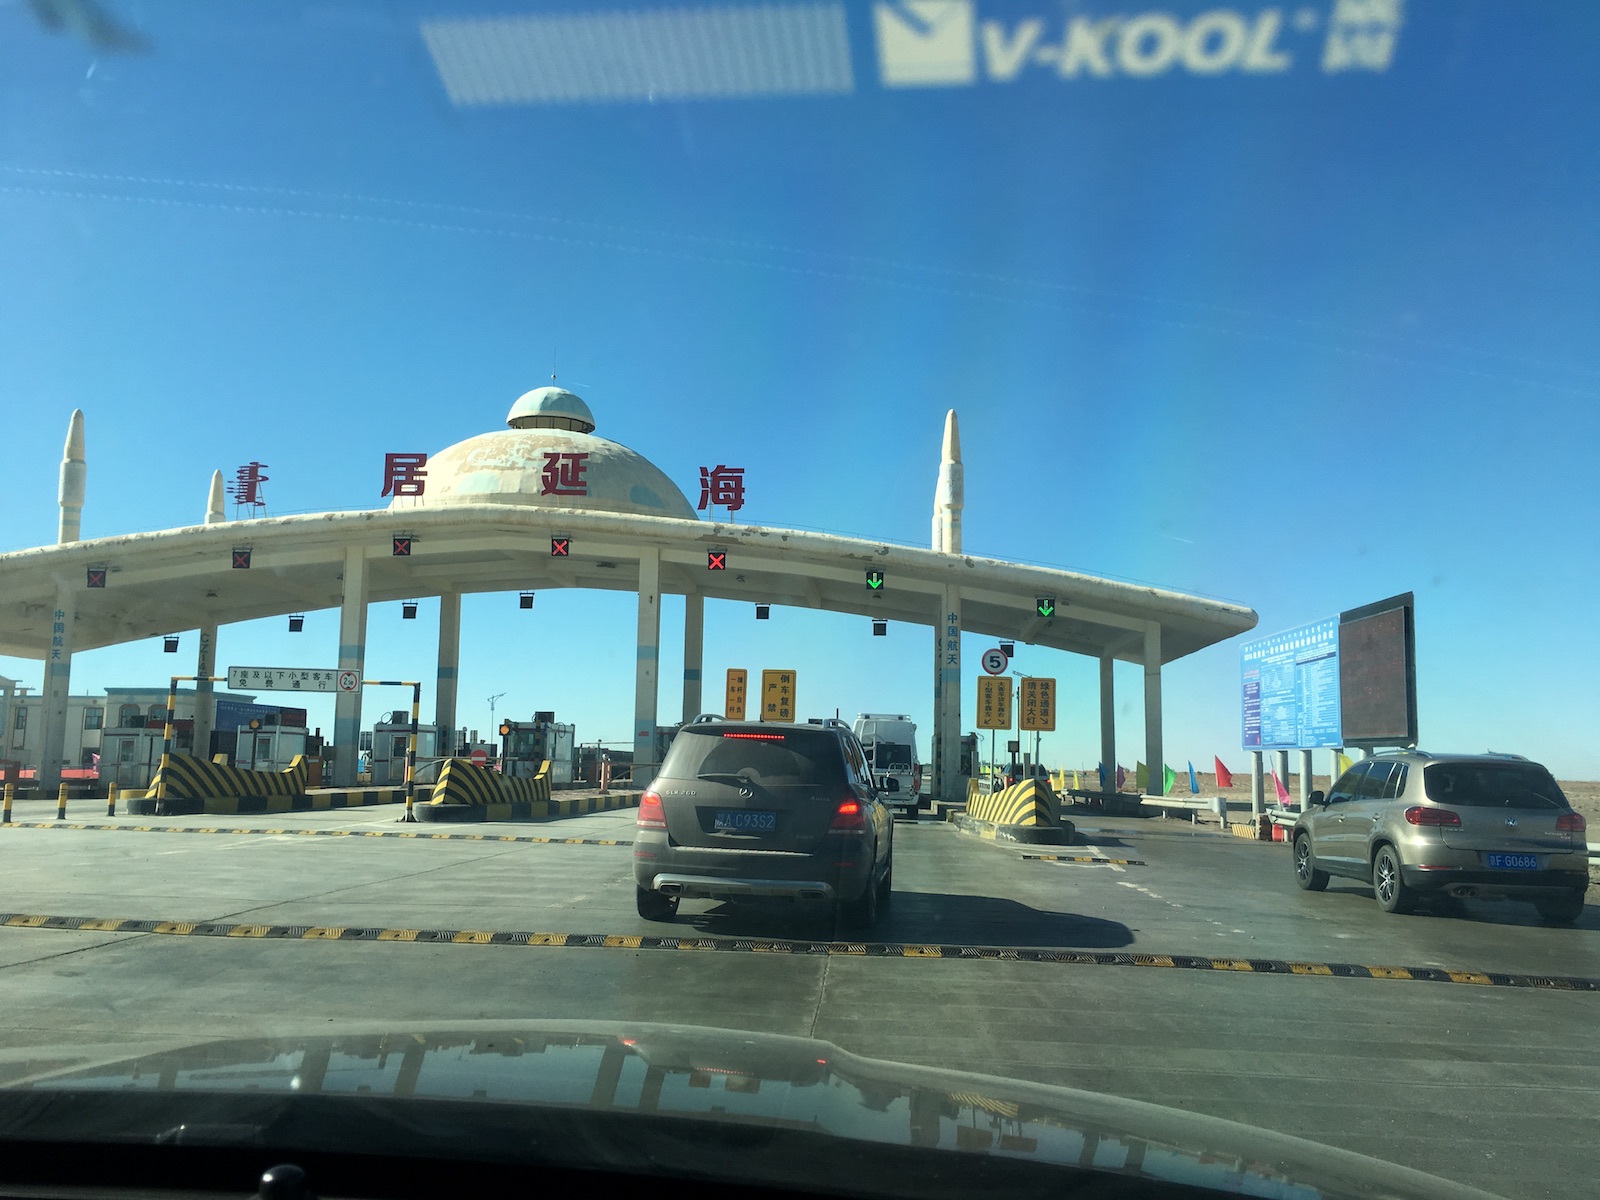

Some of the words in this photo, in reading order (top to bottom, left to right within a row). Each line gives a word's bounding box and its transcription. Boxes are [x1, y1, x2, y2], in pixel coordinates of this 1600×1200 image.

[981, 9, 1293, 83] V-KOOL
[52, 609, 65, 659] 中国航天
[947, 612, 958, 665] 中国航天
[232, 670, 333, 680] 7座及以下小型客车
[989, 655, 1002, 669] 5
[239, 678, 327, 690] 免费通行
[767, 683, 778, 713] 严禁
[1039, 681, 1050, 717] 绿色通道
[1026, 681, 1037, 725] 请关闭大灯
